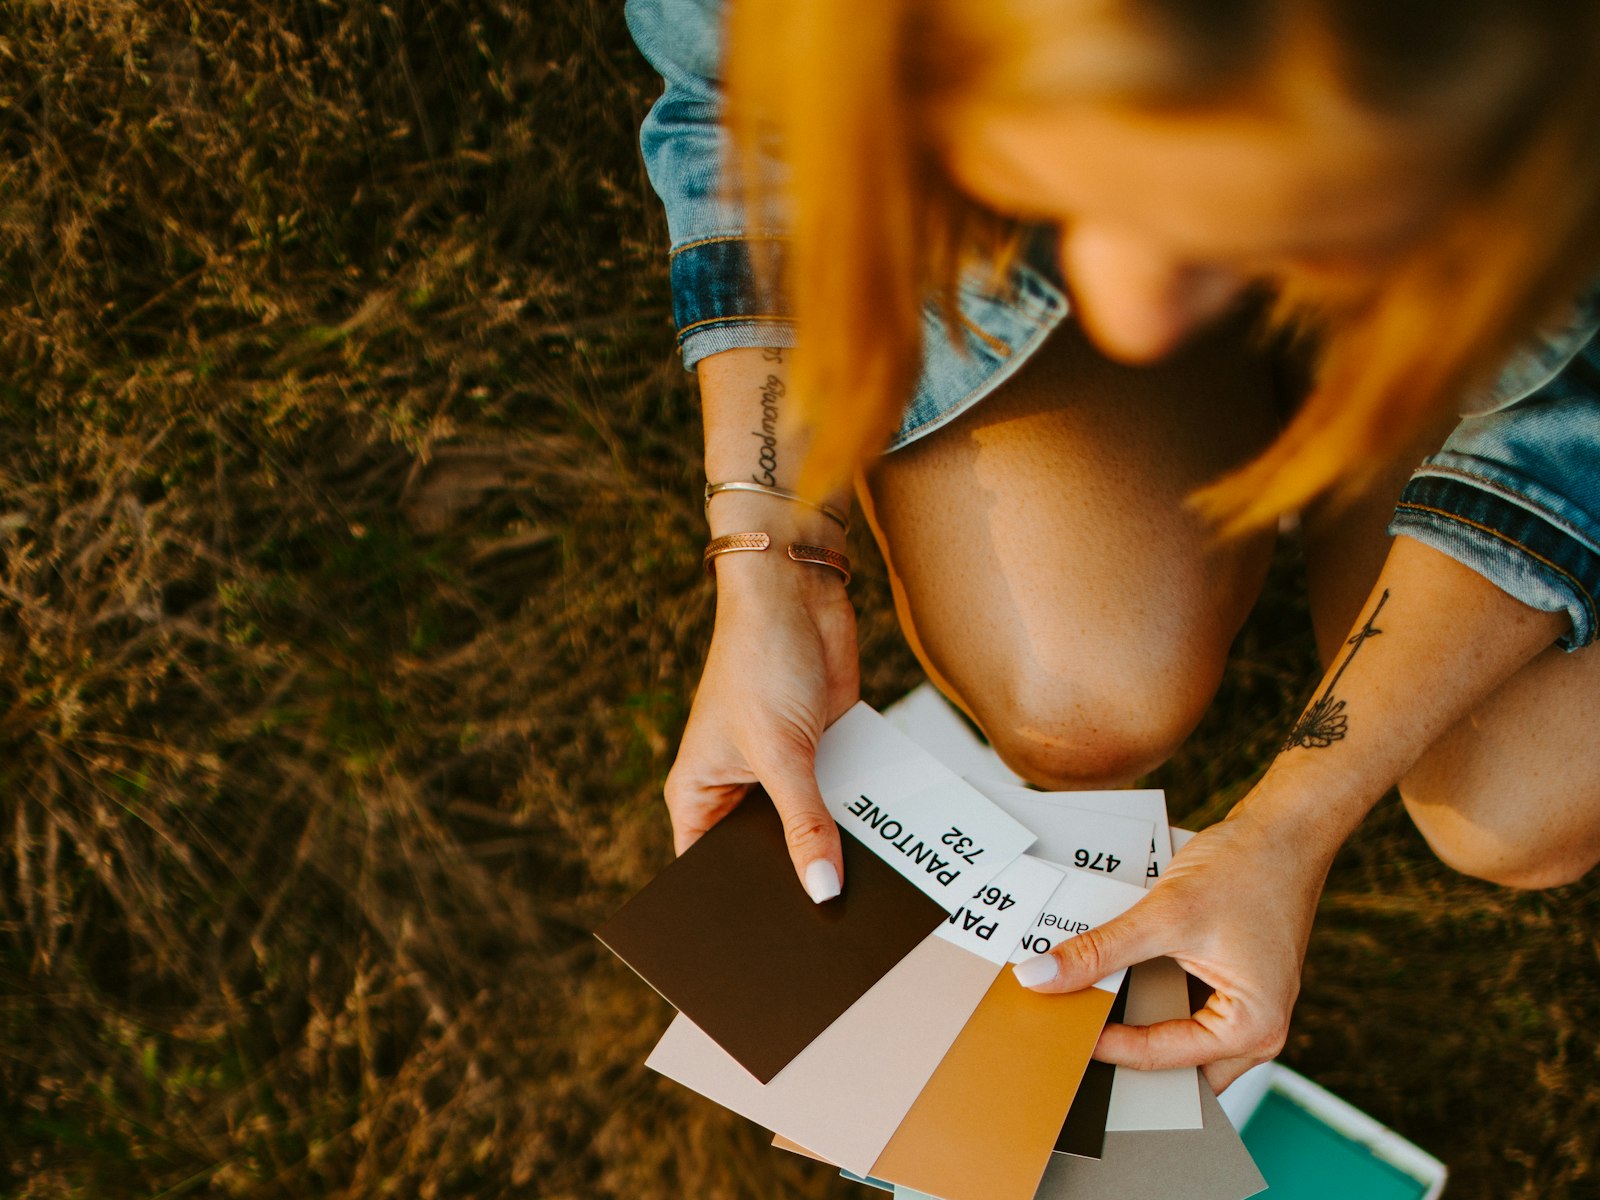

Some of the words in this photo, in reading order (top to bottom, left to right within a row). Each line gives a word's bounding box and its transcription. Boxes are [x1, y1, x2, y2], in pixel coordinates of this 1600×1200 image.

[848, 794, 961, 888] PANTONE
[940, 826, 986, 866] 732
[1074, 848, 1121, 873] 476
